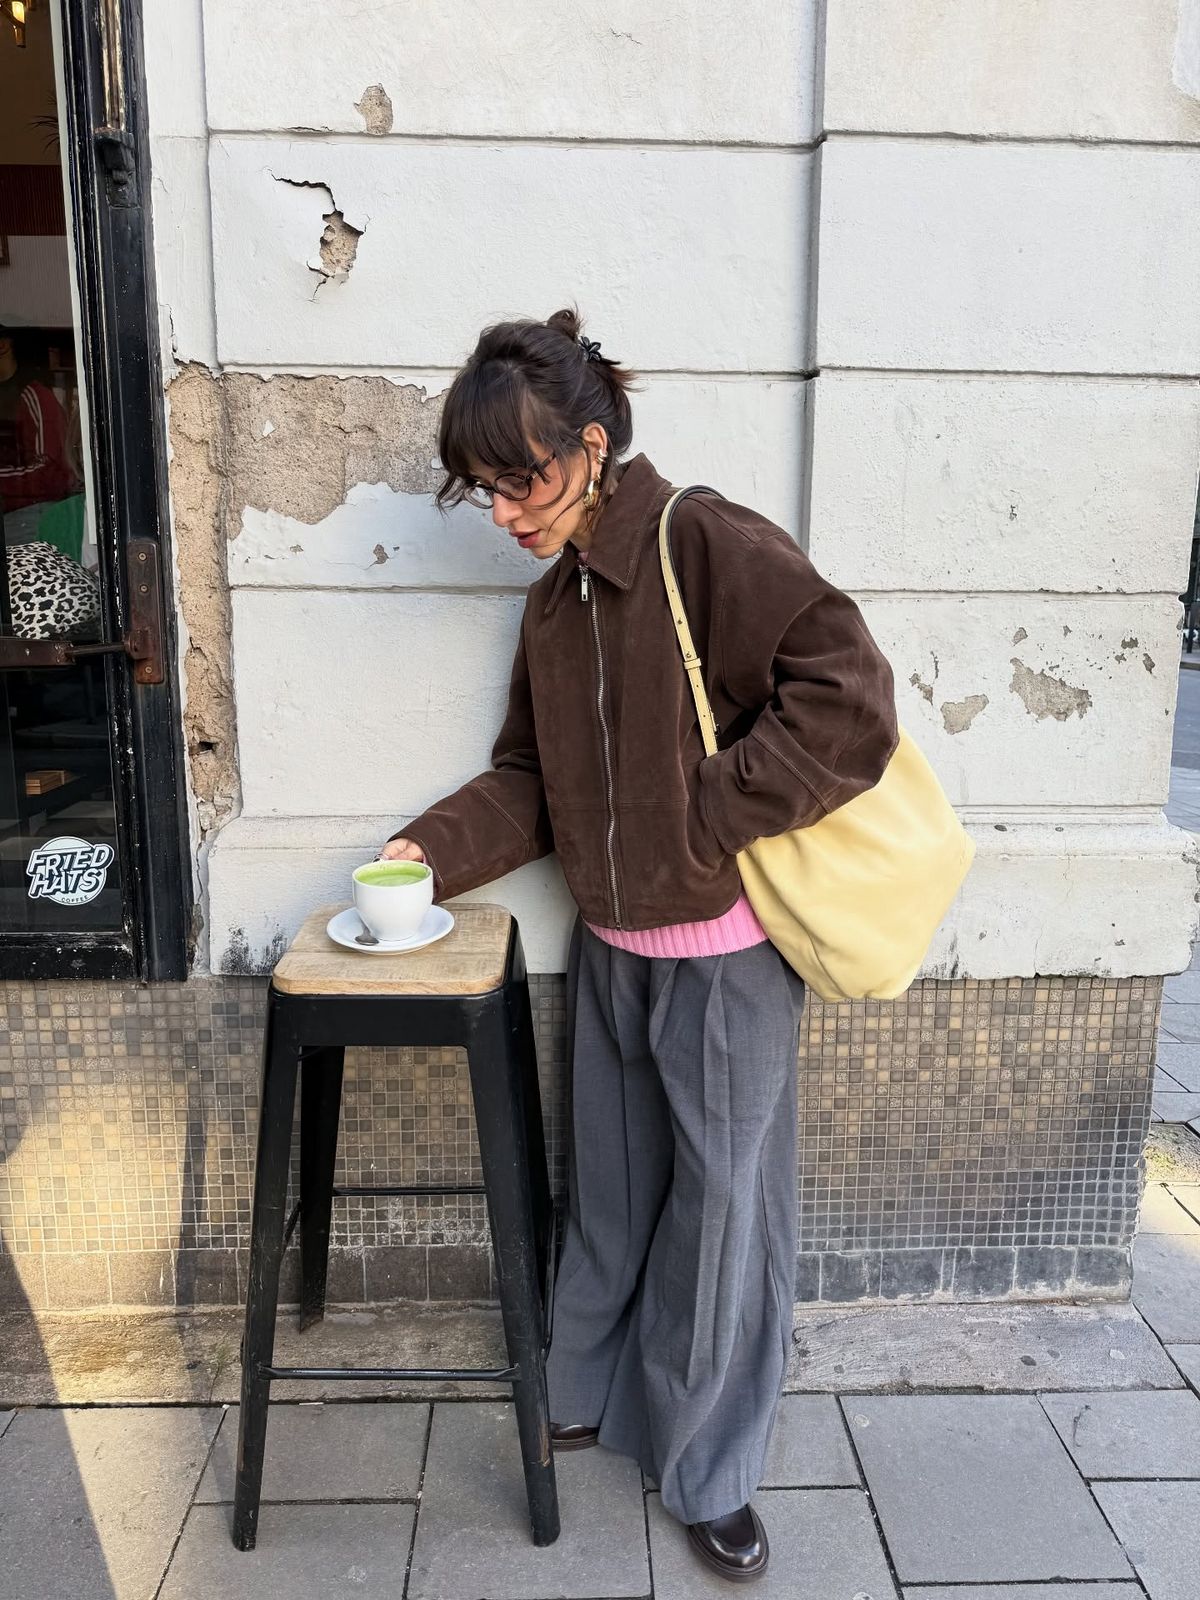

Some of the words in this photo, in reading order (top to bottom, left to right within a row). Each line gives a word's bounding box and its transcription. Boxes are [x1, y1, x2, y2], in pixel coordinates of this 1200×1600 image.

[28, 846, 112, 878] FRIED
[29, 868, 103, 896] HATS
[61, 895, 88, 903] COFFEE
